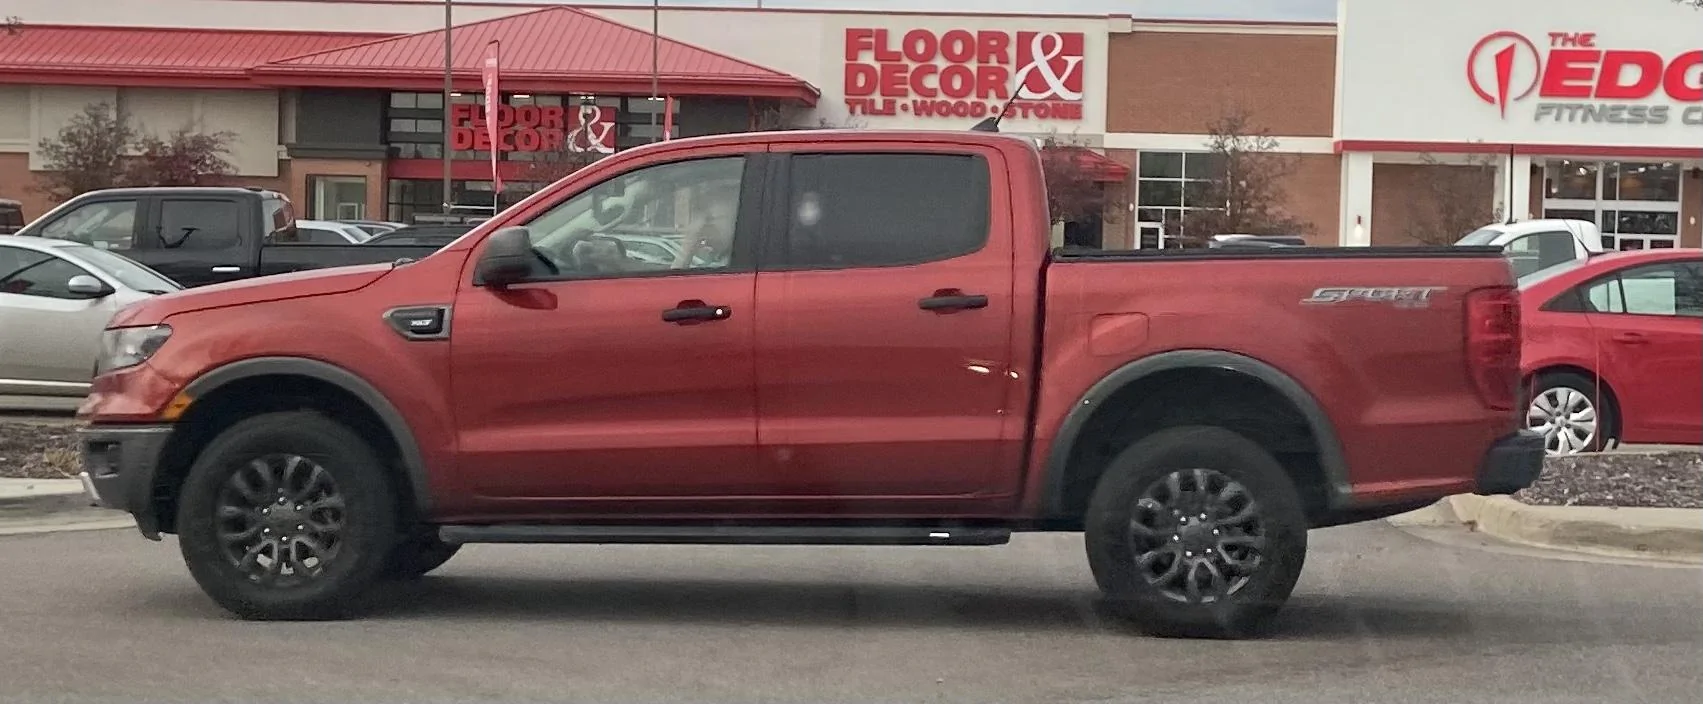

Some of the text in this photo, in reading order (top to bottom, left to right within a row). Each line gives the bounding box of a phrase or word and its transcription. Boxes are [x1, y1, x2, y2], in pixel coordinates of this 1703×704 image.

[845, 28, 1010, 64] FLOOR
[1547, 32, 1597, 47] THE
[844, 63, 1009, 99] DECOR
[452, 103, 565, 129] FLOOR
[845, 98, 1083, 120] TILE WOOD STONE
[1534, 103, 1670, 124] FITNESS
[451, 128, 565, 151] DECOR
